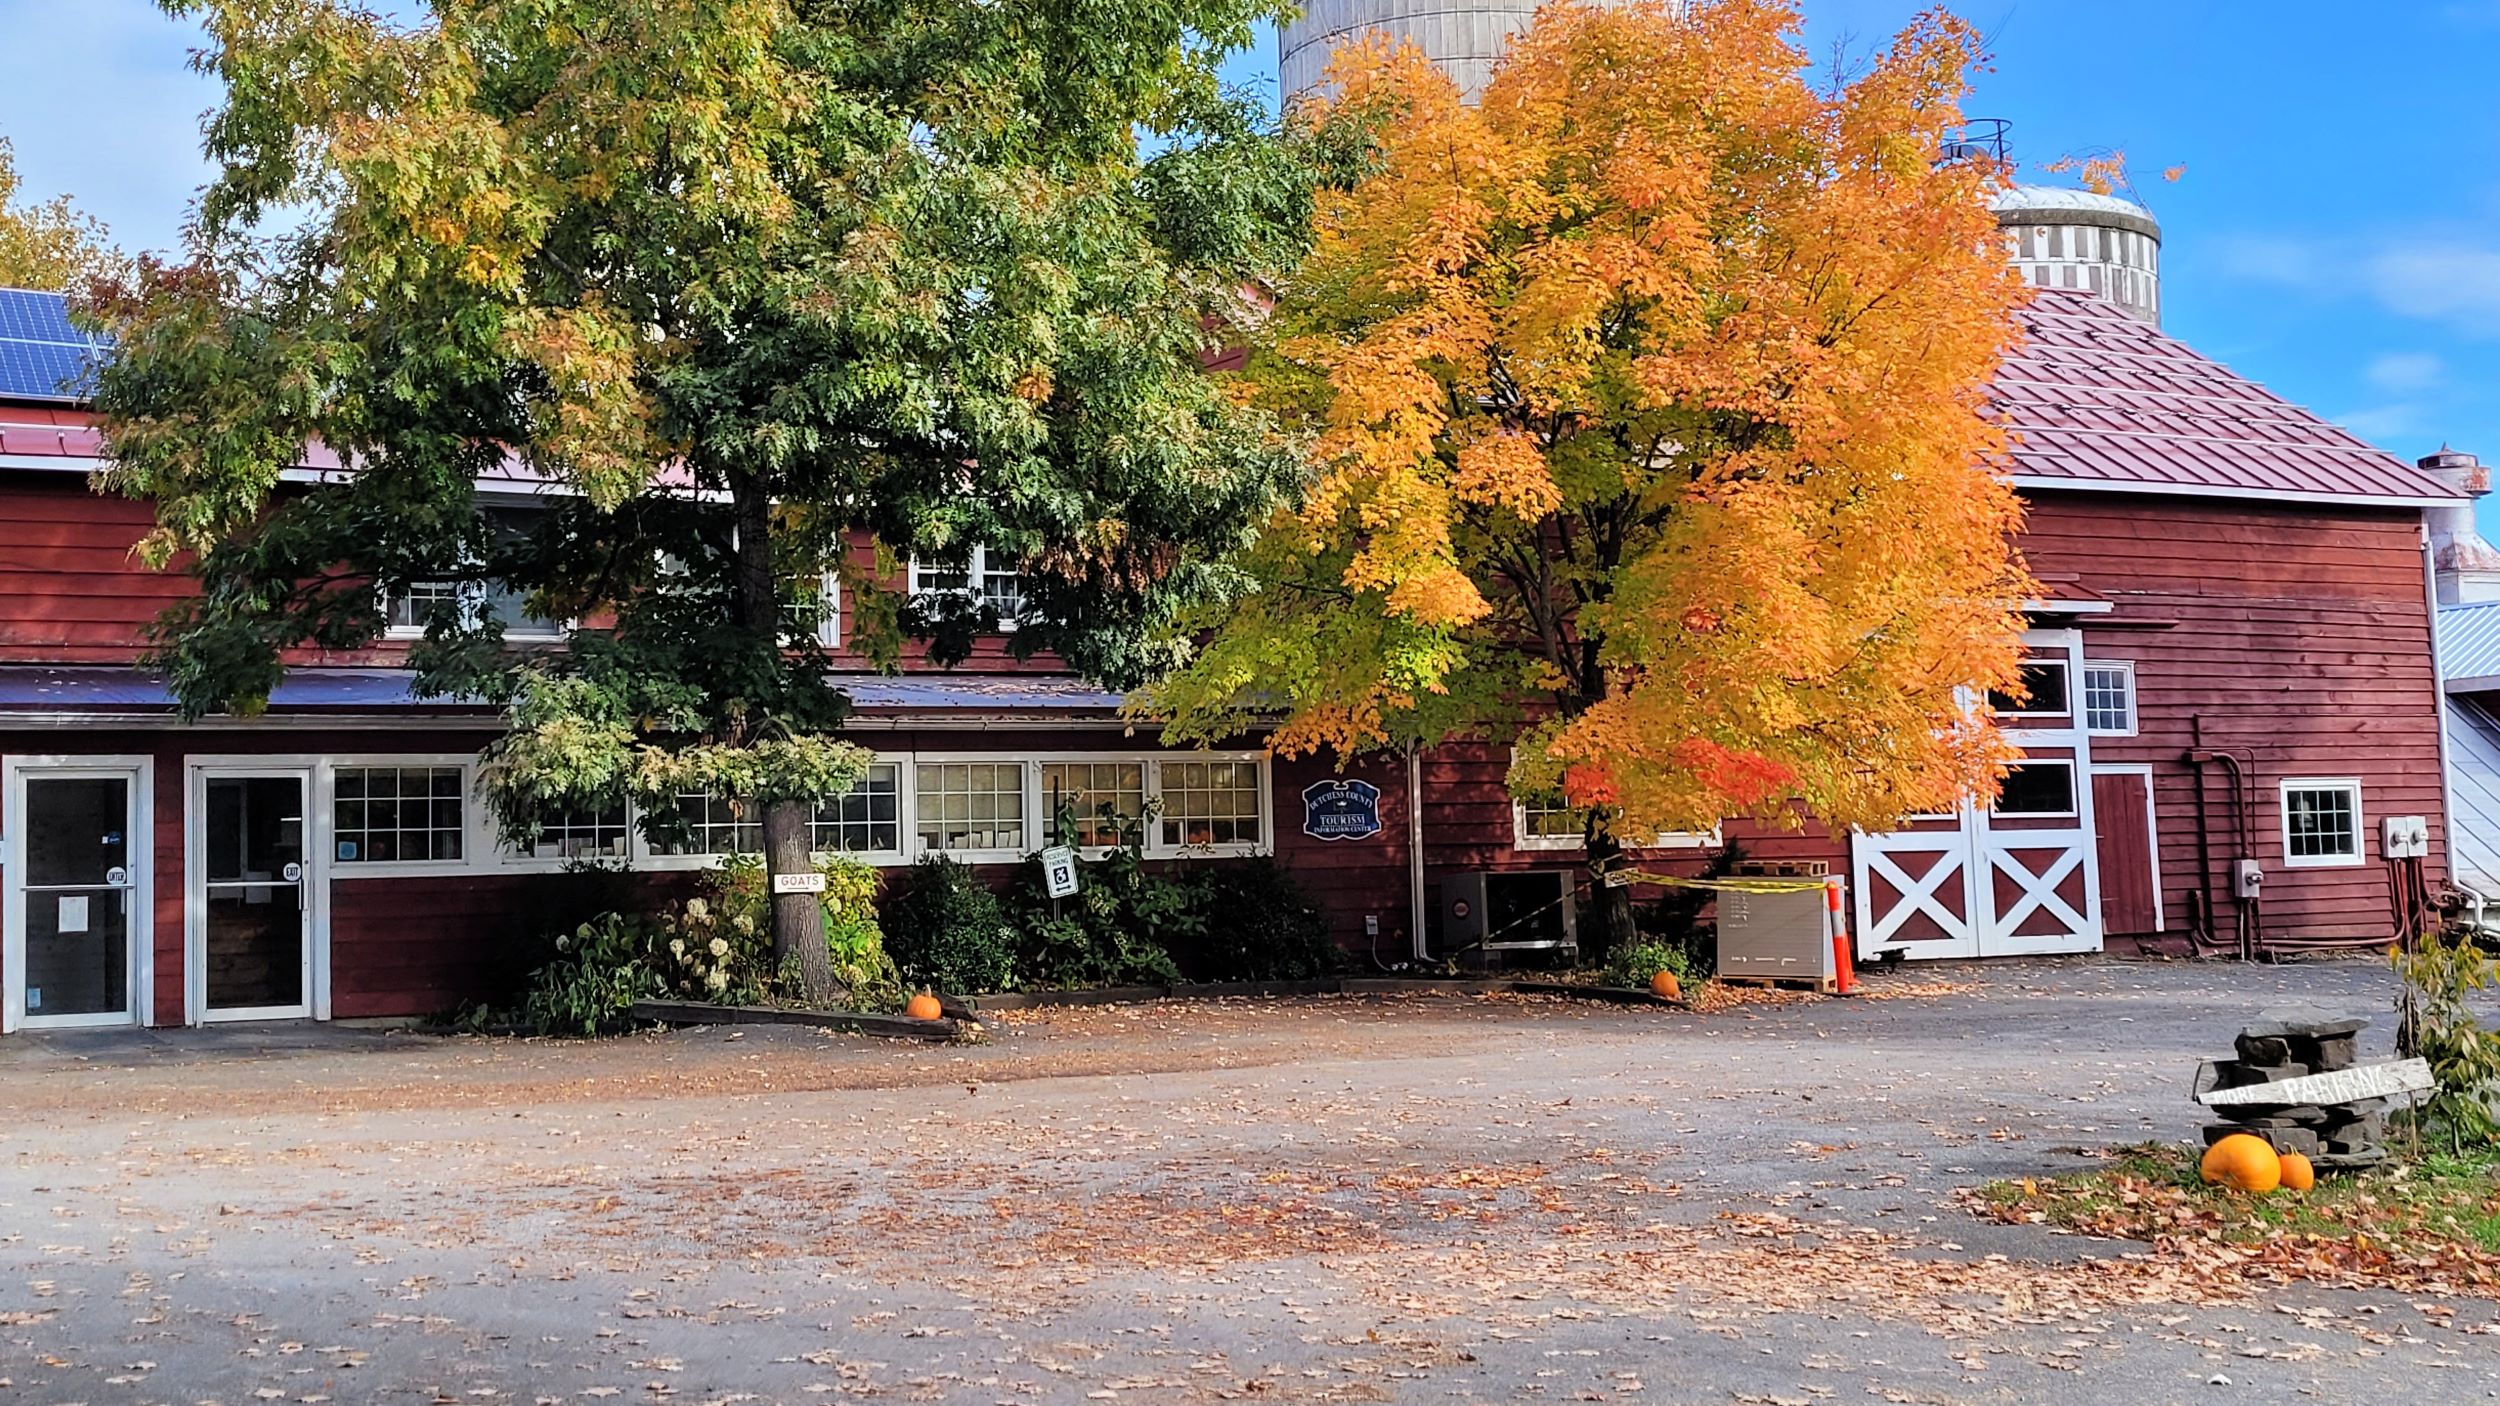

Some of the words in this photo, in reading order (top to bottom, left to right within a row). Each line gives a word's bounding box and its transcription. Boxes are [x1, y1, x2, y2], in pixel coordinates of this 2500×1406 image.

[1309, 791, 1345, 810] DUTCHESS
[1346, 791, 1373, 808] COUNTY
[1320, 815, 1365, 825] TOURISM
[1350, 825, 1372, 833] CENTER
[286, 866, 298, 877] EXIT
[781, 875, 819, 886] GOATS
[2282, 1065, 2390, 1104] PARKING
